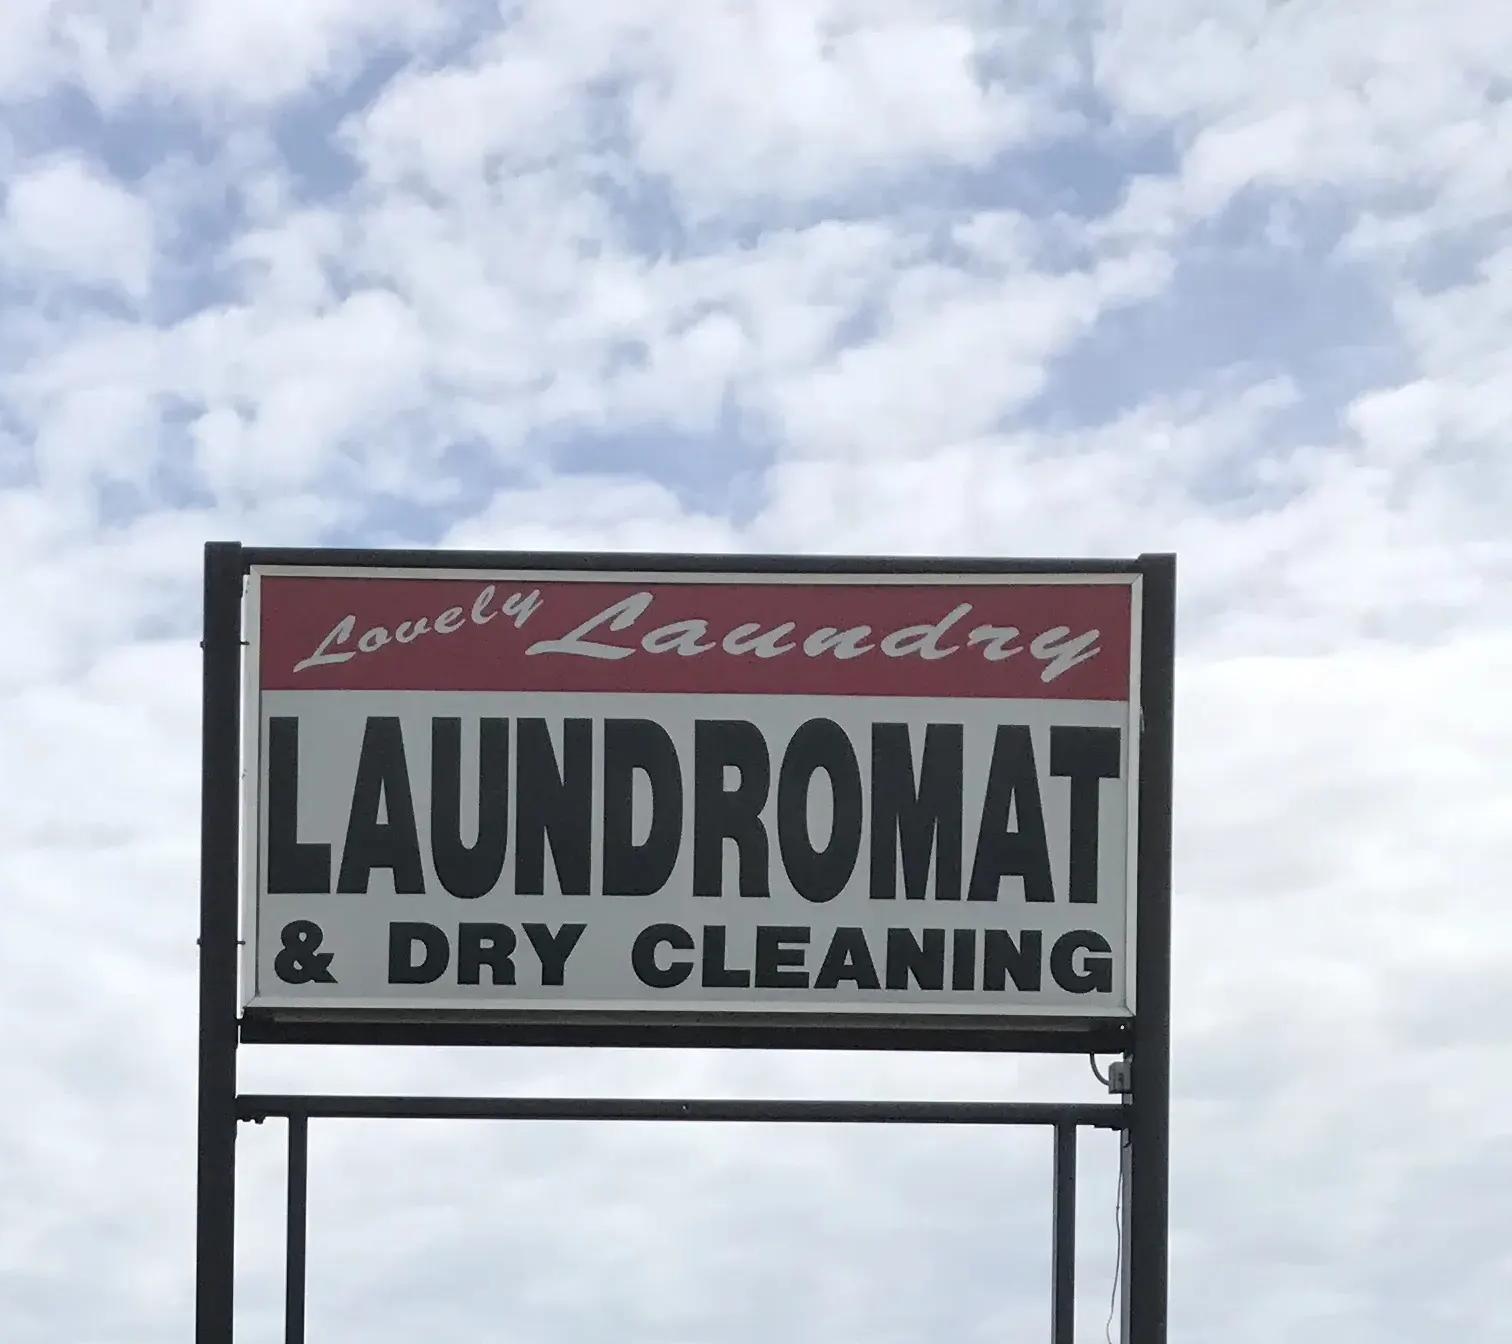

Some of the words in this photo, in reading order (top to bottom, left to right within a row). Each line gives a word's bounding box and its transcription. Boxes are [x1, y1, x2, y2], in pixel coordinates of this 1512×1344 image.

[292, 584, 543, 673] Lovely
[524, 591, 1101, 683] Laundry
[266, 715, 1122, 905] LAUNDROMAT
[274, 920, 338, 985] &
[388, 922, 586, 987] DRY
[631, 923, 1113, 994] CLEANING
